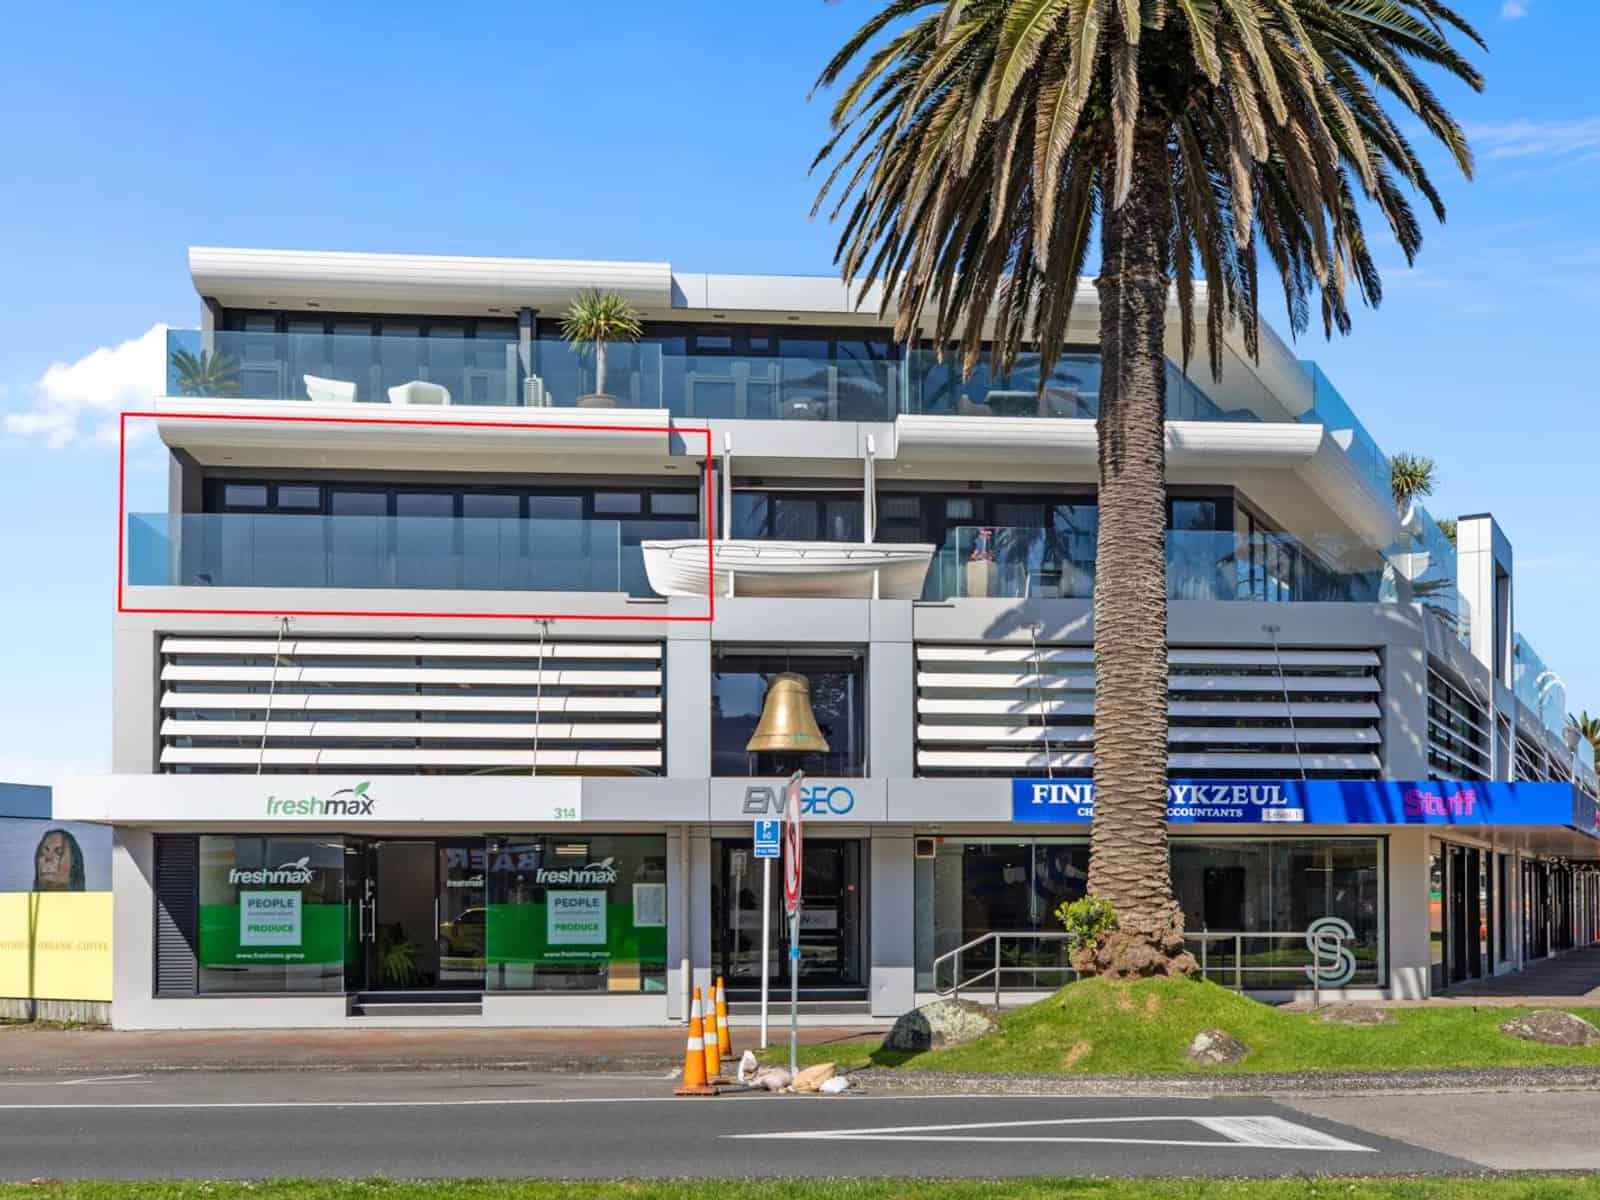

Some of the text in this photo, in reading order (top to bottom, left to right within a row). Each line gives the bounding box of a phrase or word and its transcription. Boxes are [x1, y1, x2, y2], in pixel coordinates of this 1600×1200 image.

[1167, 785, 1288, 805] YKZEUL
[266, 795, 375, 815] freshmax
[1405, 789, 1476, 816] Stuff
[553, 807, 576, 819] 314
[1167, 807, 1243, 817] CCOUNTANTS
[763, 821, 772, 833] P
[229, 867, 312, 884] freshmax
[536, 867, 617, 884] freshmax
[247, 898, 295, 908] PEOPLE
[554, 897, 600, 908] PEOPLE
[247, 923, 294, 933] PRODUCE
